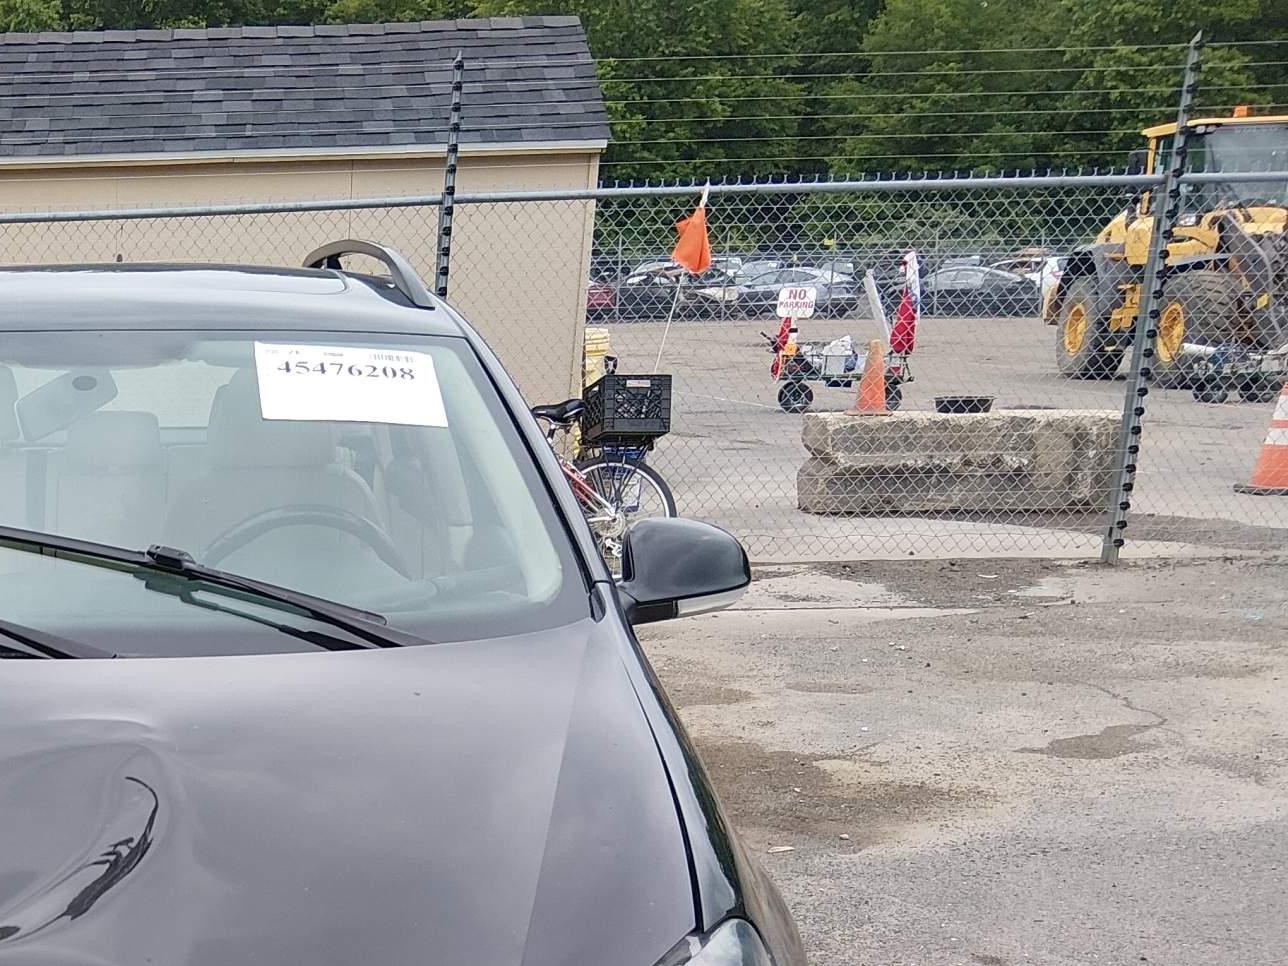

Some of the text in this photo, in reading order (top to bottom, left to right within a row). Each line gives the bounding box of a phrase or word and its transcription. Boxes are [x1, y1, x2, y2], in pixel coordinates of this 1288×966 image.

[788, 289, 807, 300] NO
[778, 301, 814, 309] PARKING
[277, 360, 415, 380] 45476208
